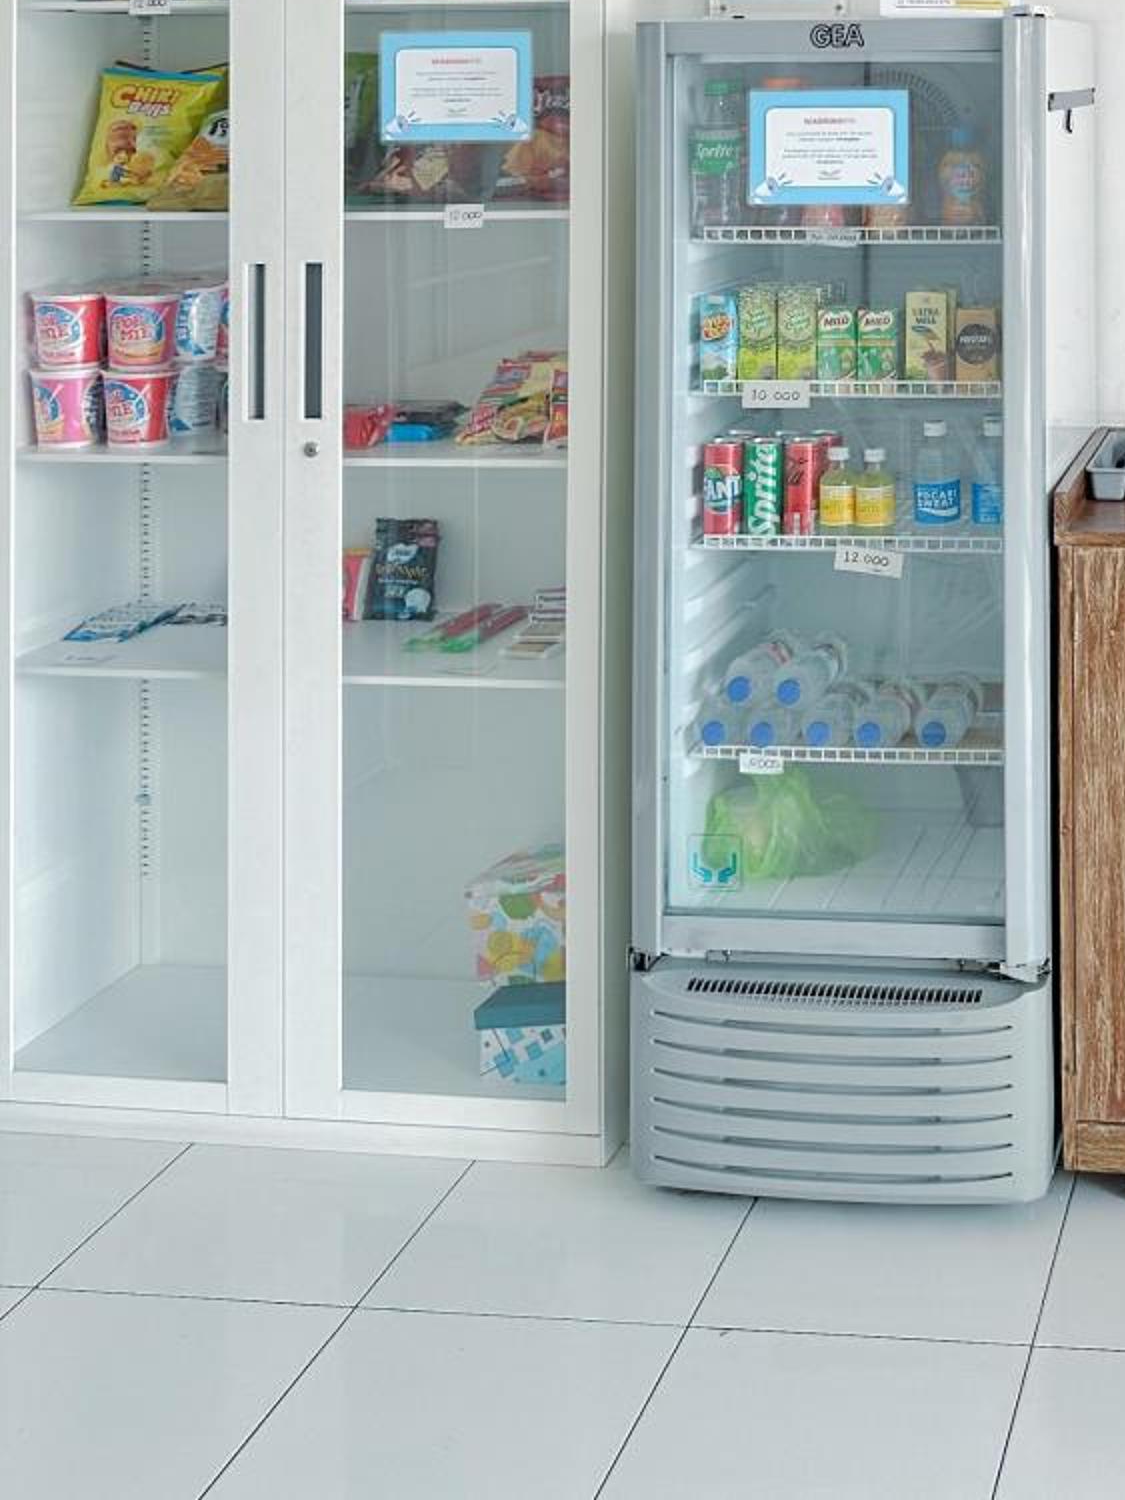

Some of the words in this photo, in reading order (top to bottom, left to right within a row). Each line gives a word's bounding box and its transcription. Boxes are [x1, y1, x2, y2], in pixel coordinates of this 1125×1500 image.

[810, 23, 864, 48] GEA
[748, 443, 780, 535] Sprite
[917, 489, 957, 501] POCARI
[917, 498, 954, 508] SWEAT
